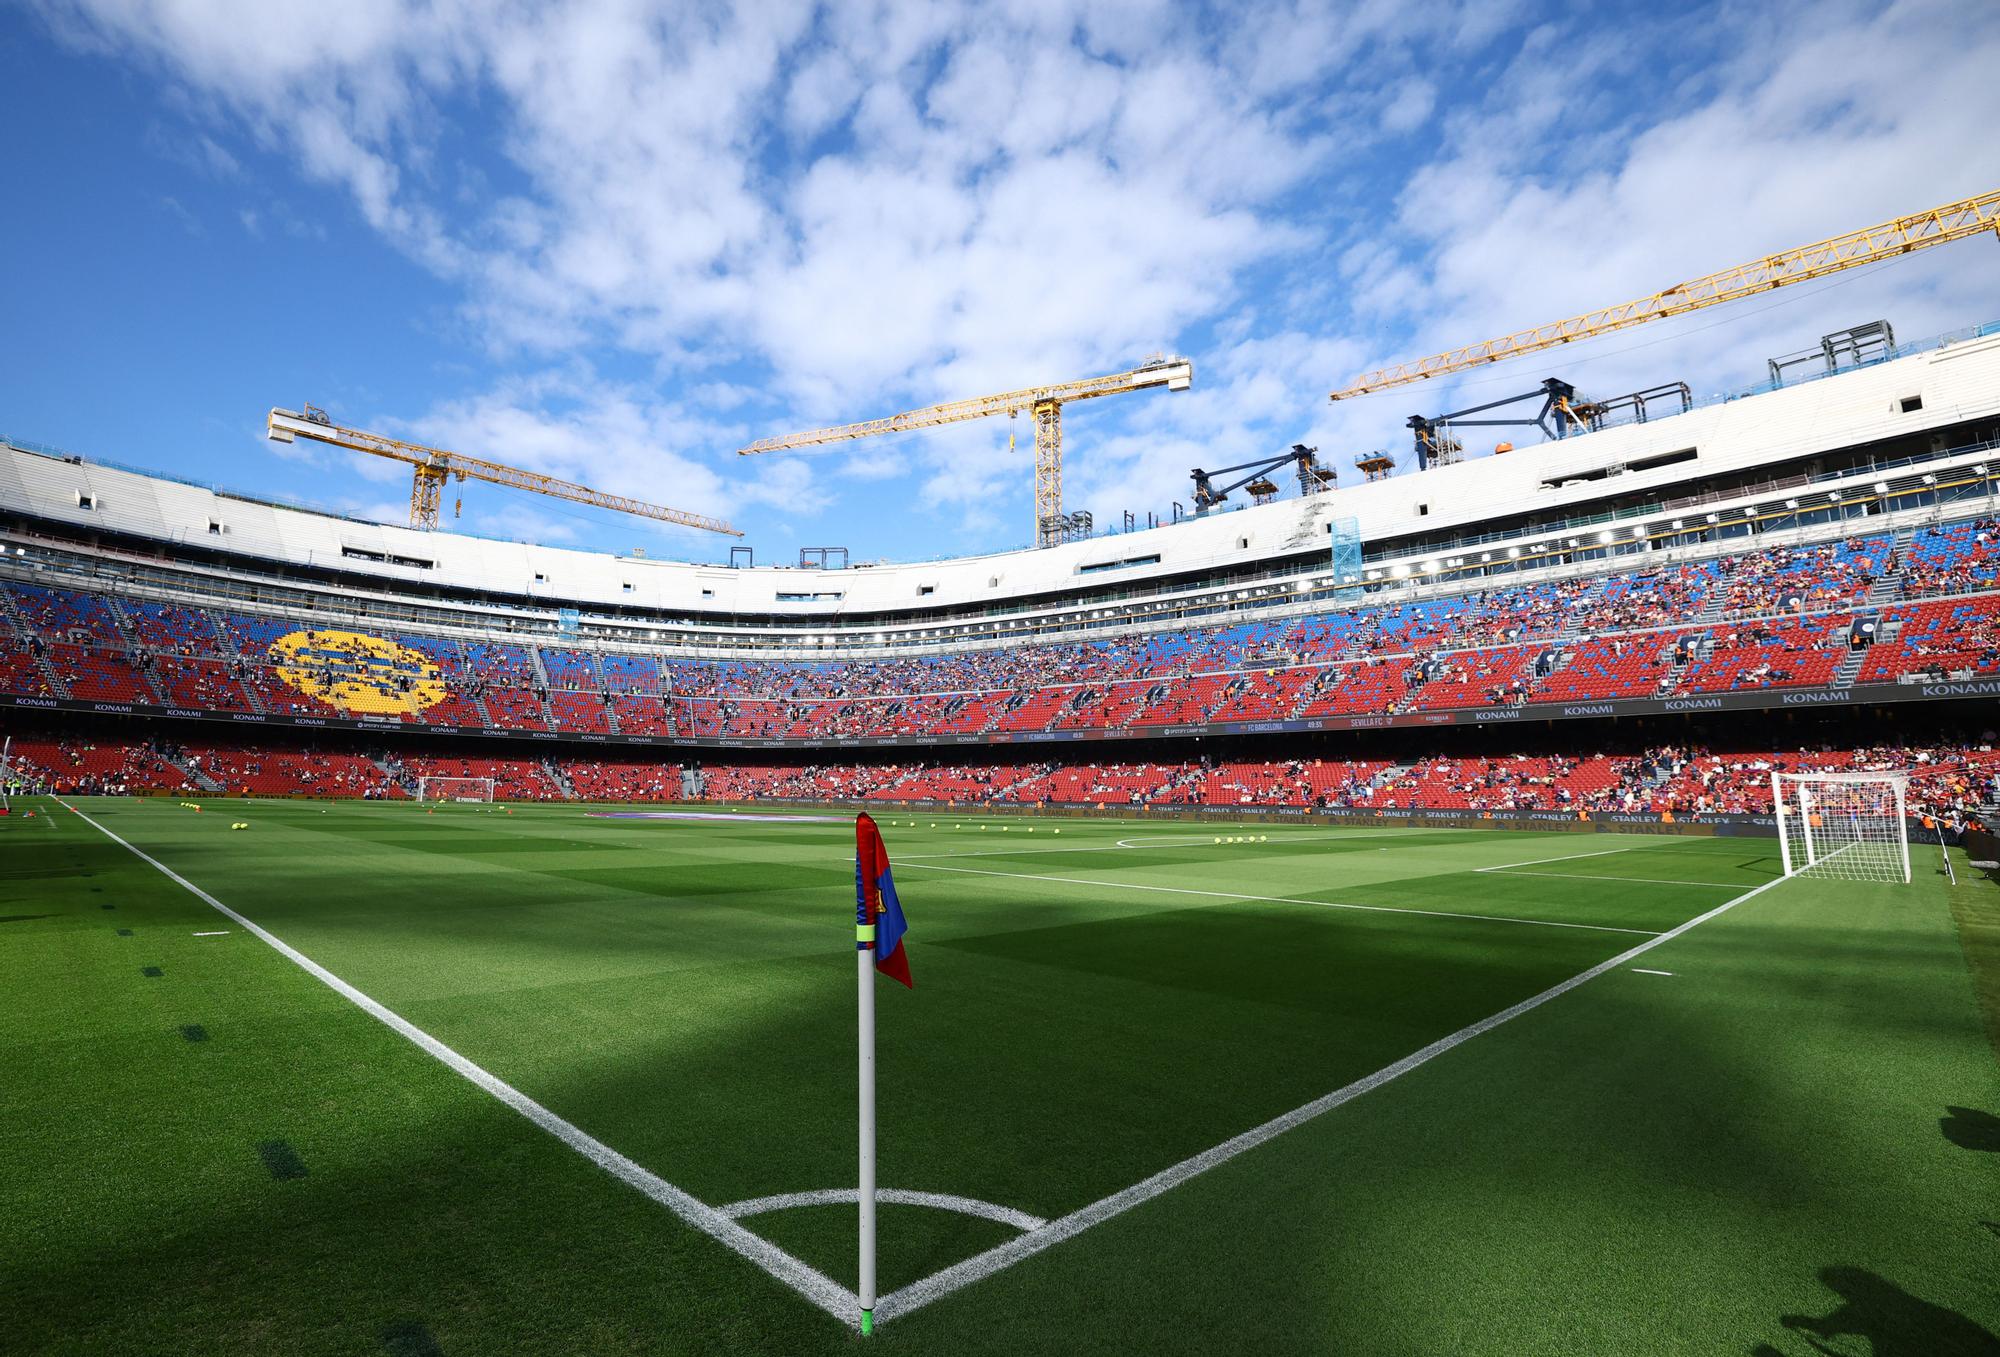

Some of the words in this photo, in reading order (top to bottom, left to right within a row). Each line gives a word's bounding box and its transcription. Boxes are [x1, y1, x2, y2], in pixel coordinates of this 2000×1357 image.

[16, 697, 57, 707] KONAMI
[1783, 691, 1850, 704] KONAMI
[95, 703, 132, 713] KONAMI
[1665, 699, 1722, 710] KONAMI
[167, 709, 201, 718] KONAMI
[1564, 705, 1613, 716] KONAMI
[233, 714, 265, 722] KONAMI
[1475, 711, 1519, 720] KONAMI
[294, 718, 325, 726] KONAMI
[1351, 718, 1374, 727] SEVILLA
[1374, 717, 1382, 725] FC
[1254, 723, 1283, 731] BARCELONA
[1274, 814, 1312, 823] STANLEY
[1477, 812, 1515, 820] SNLEY
[1530, 813, 1572, 821] STANLEY
[1612, 815, 1657, 823] STANLEY
[1344, 817, 1388, 826] STANLEY
[1425, 818, 1473, 829] STANLEY
[1515, 820, 1572, 831] STANLEY
[1619, 823, 1685, 834] STANLEY
